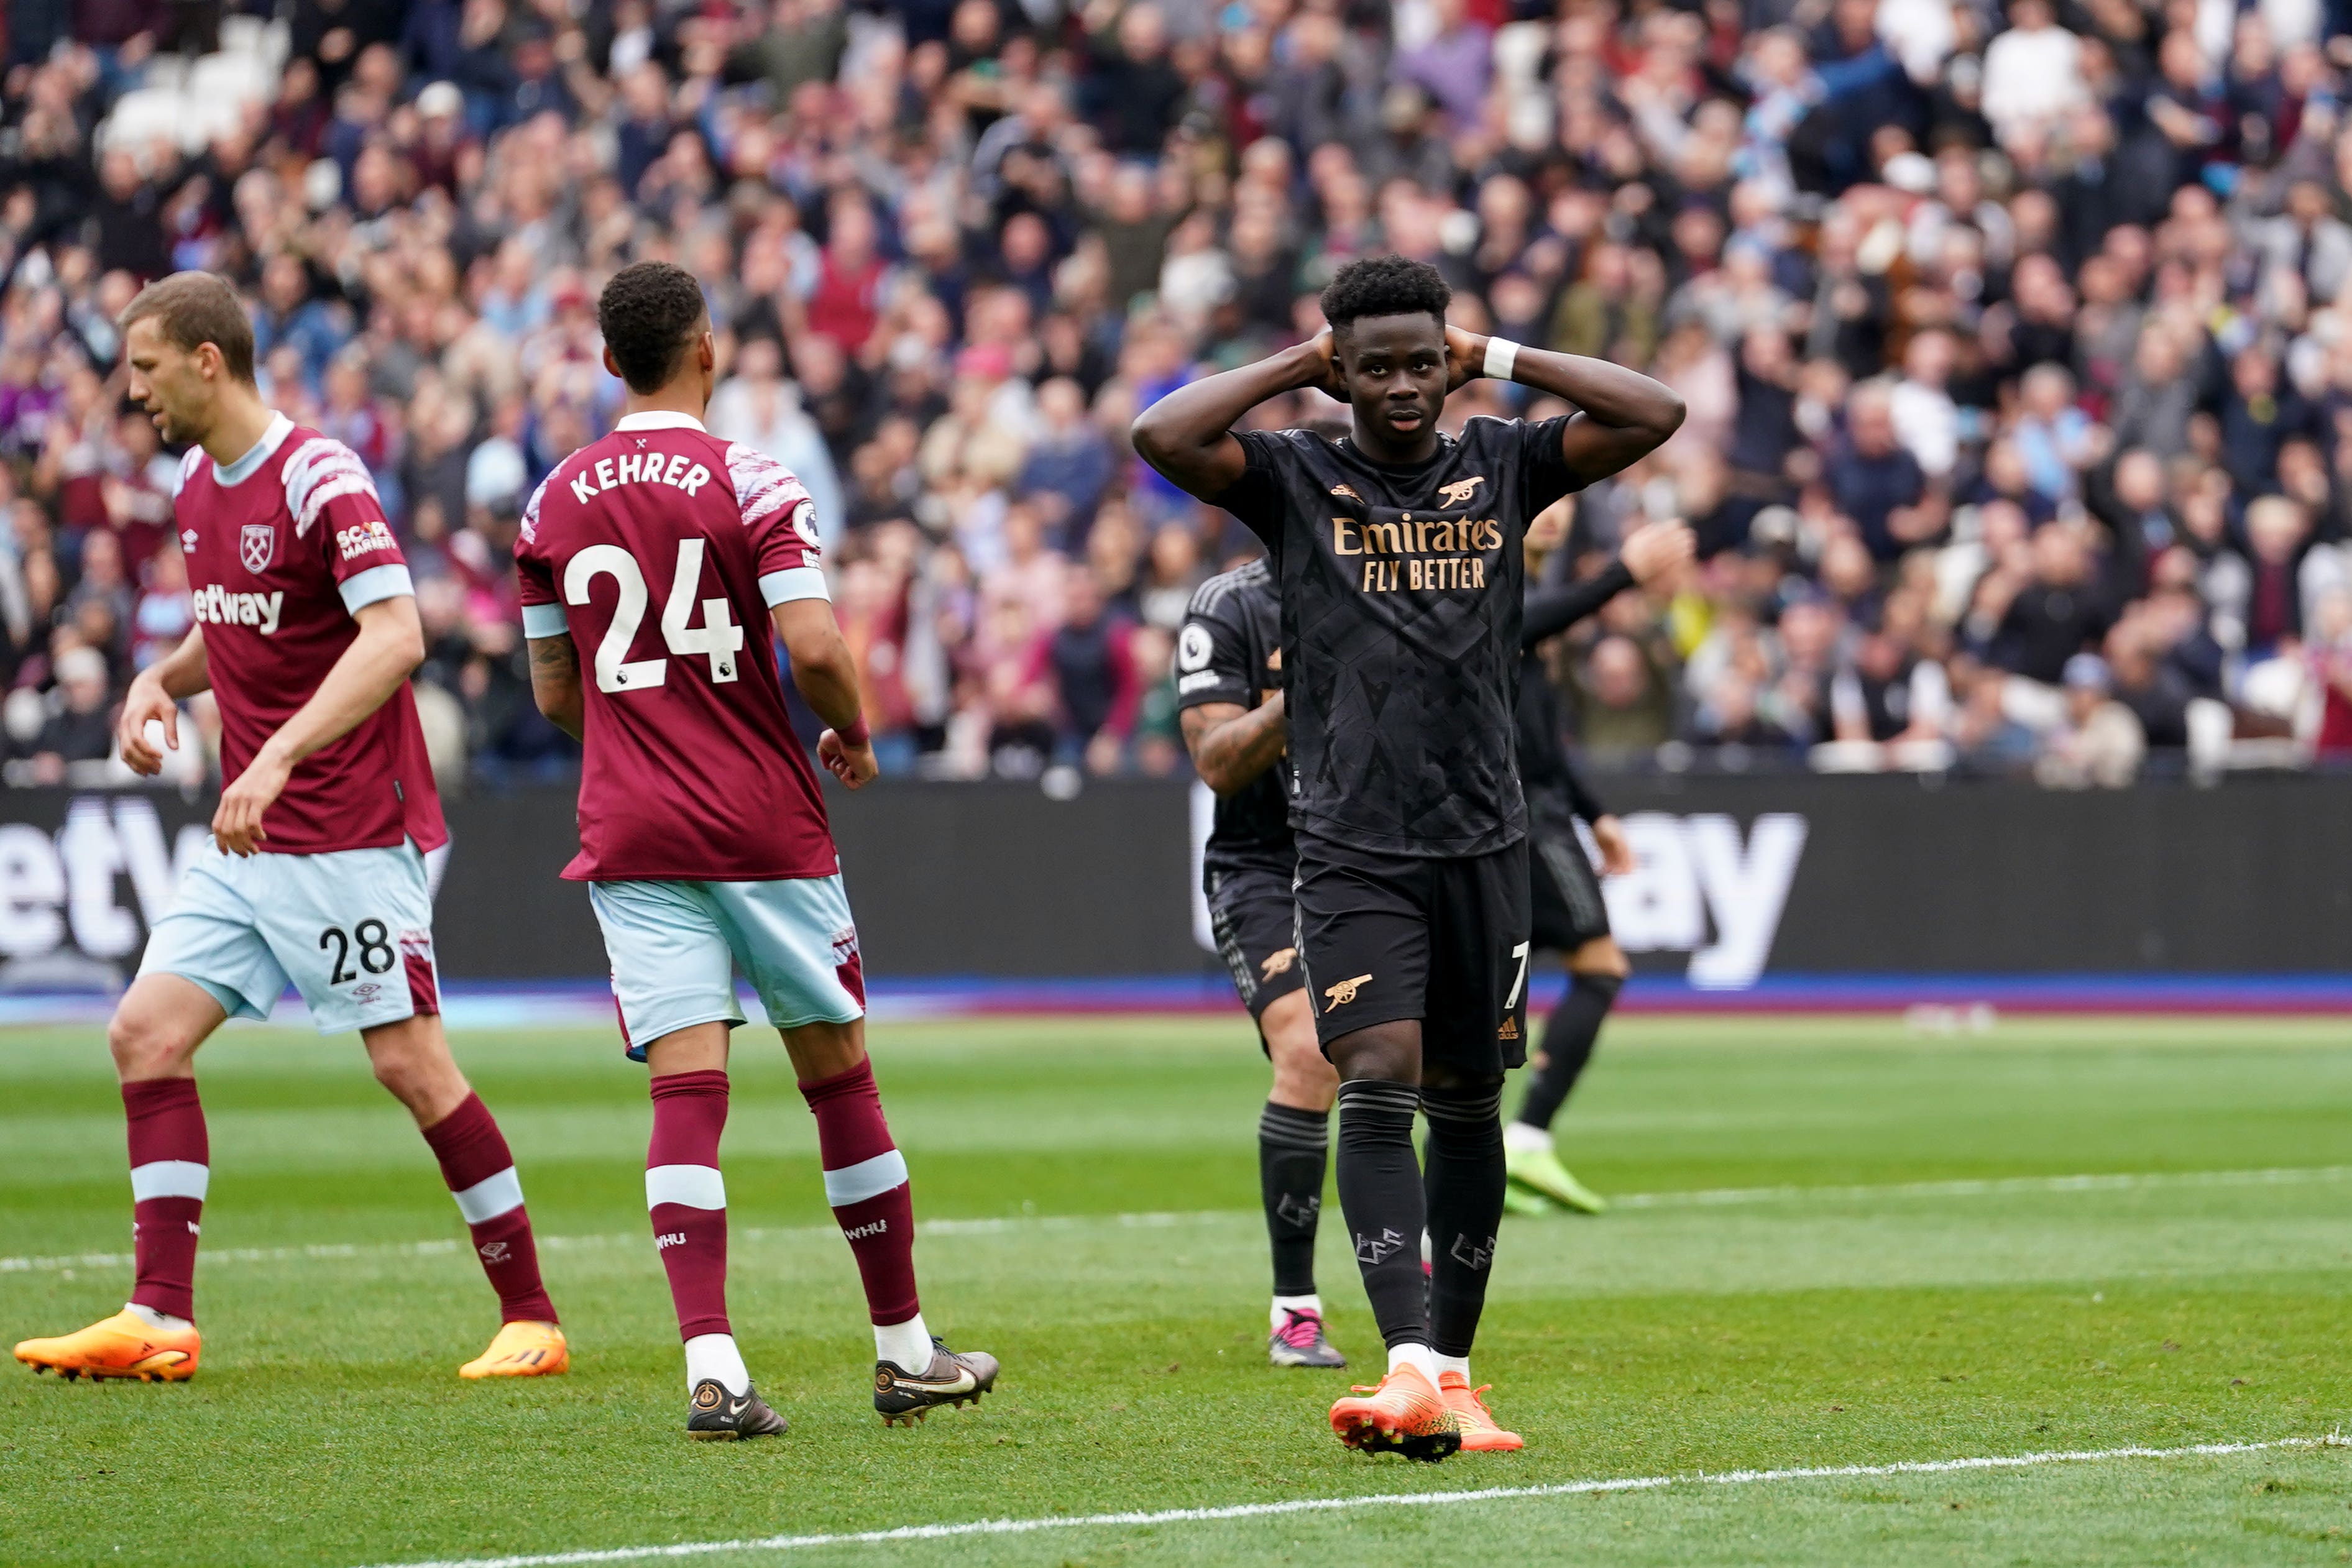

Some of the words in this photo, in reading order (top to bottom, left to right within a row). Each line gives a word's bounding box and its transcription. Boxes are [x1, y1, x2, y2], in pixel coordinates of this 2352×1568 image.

[570, 452, 711, 505] KEHRER
[1331, 511, 1504, 556] Emirates
[1362, 561, 1400, 593] FLY
[1409, 557, 1486, 590] BETTER
[563, 538, 744, 694] 24
[319, 918, 396, 986] 28
[1512, 940, 1530, 1009] 7
[845, 1219, 888, 1240] WHU
